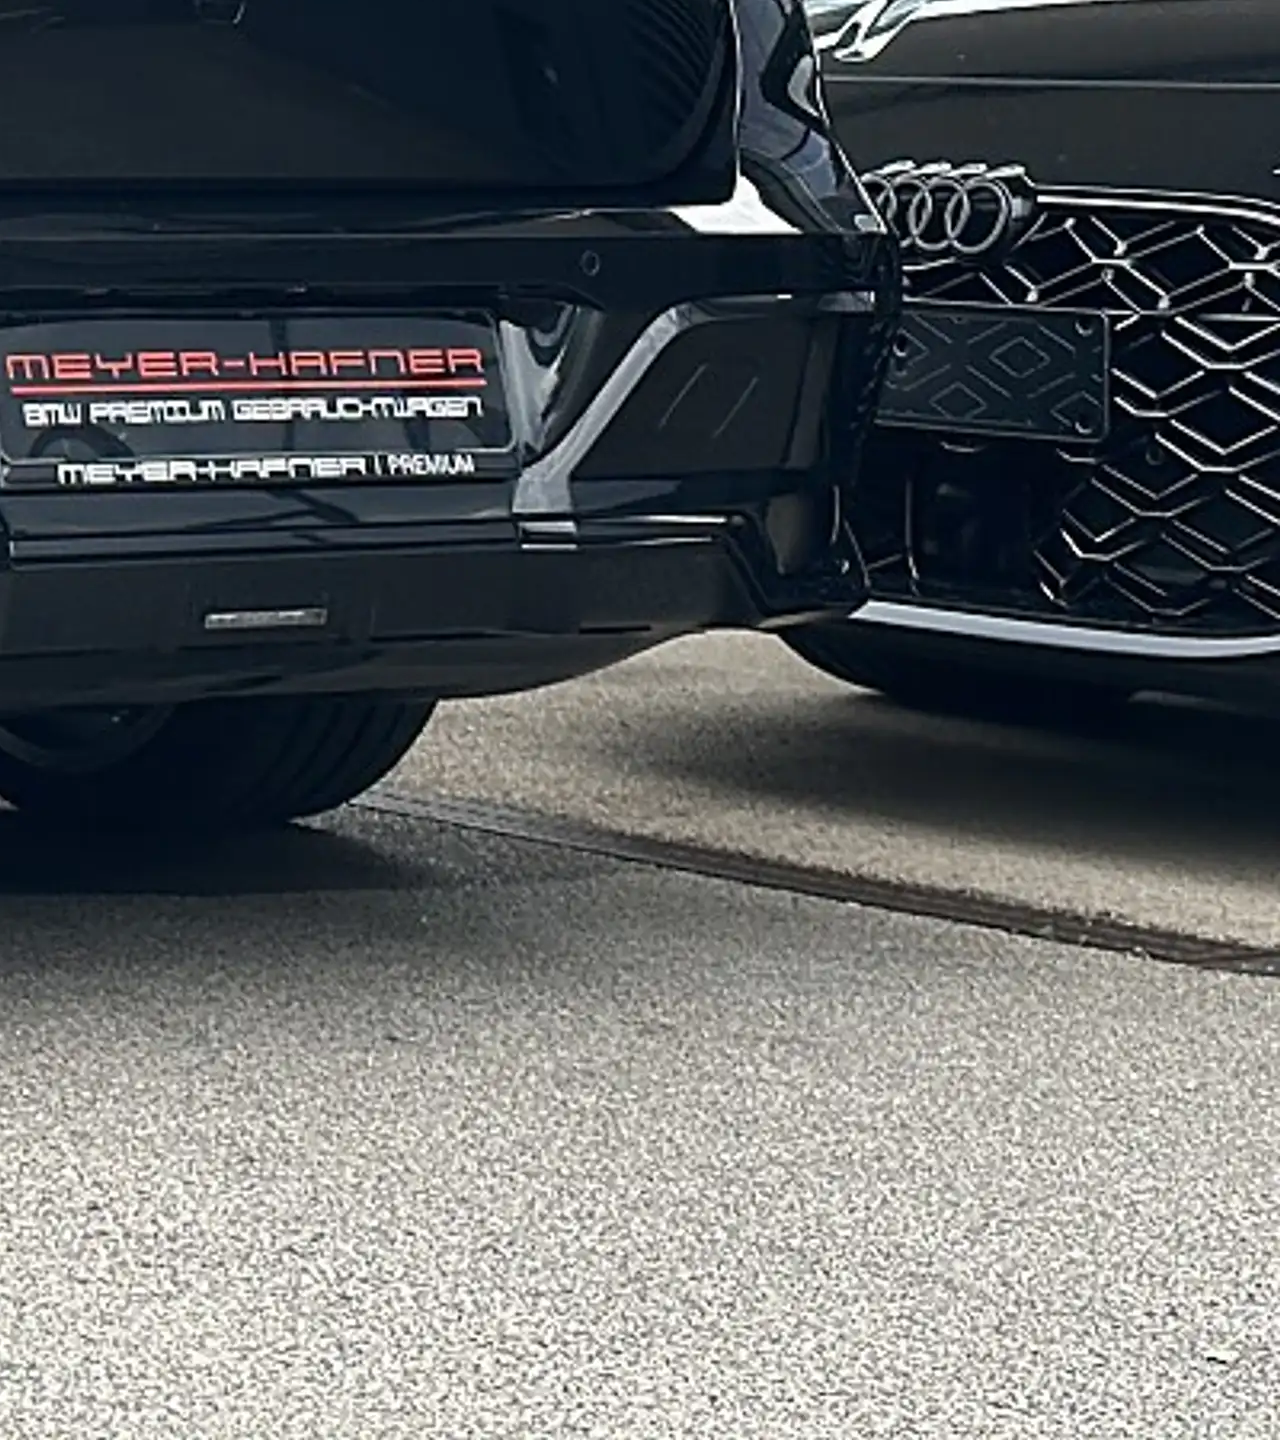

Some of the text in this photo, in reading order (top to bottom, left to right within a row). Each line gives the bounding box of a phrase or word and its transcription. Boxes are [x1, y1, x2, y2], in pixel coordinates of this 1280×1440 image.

[6, 348, 484, 380] MEYER-HAFNER
[22, 402, 82, 427] BMW
[89, 399, 226, 425] PREMIUM
[57, 453, 476, 485] MEYER-HAFNER PREMIUM
